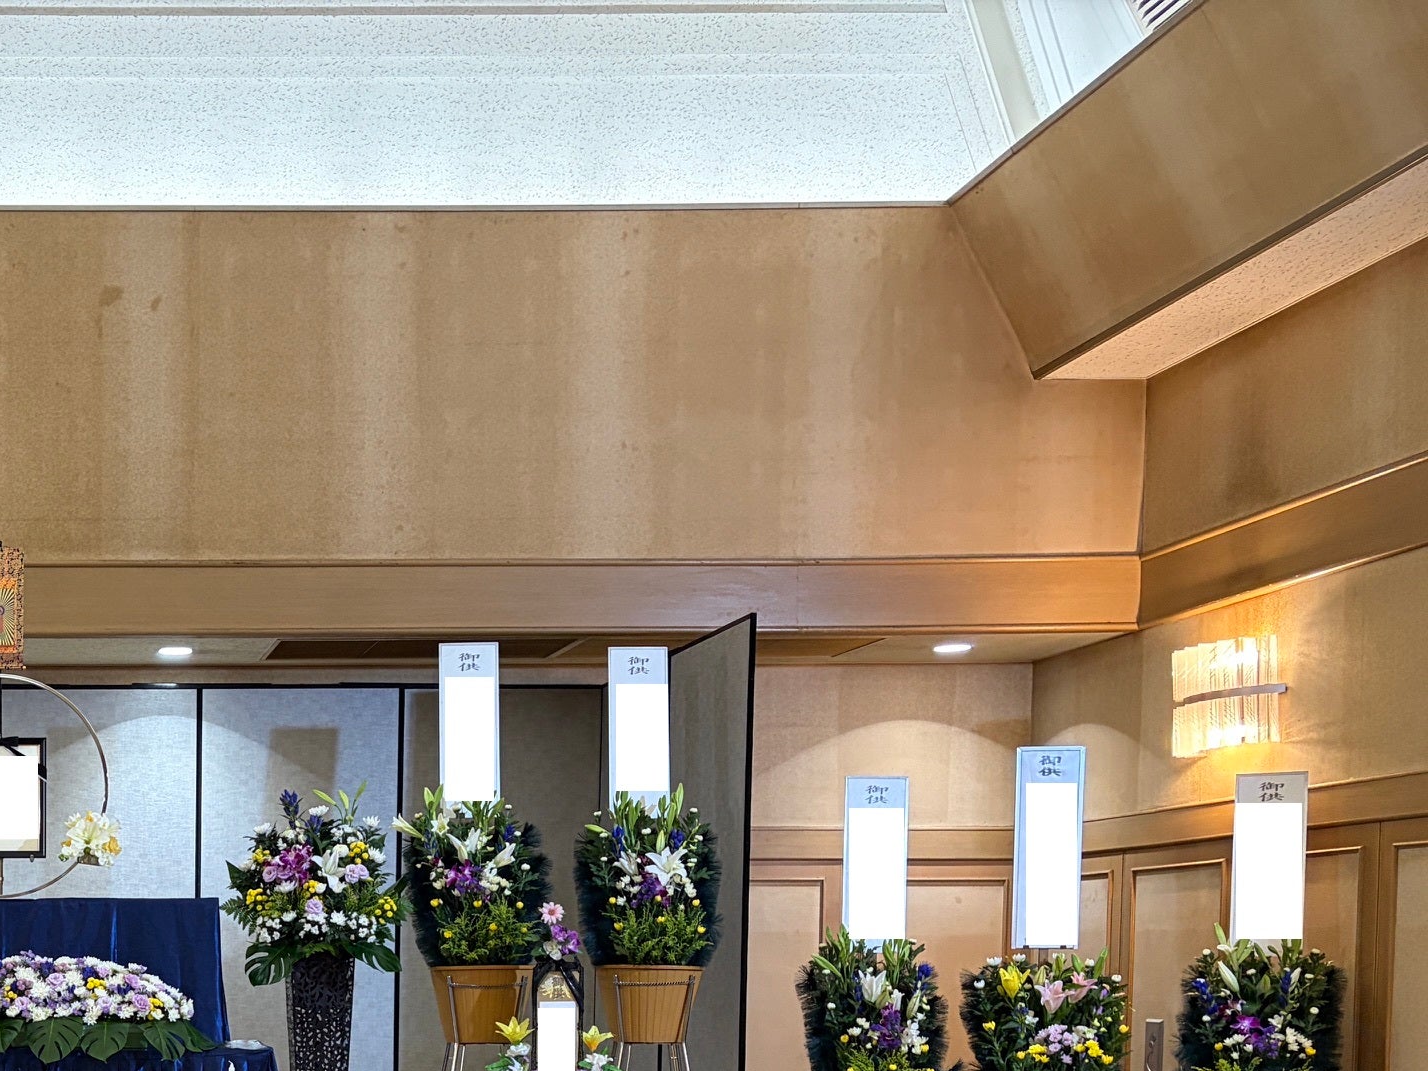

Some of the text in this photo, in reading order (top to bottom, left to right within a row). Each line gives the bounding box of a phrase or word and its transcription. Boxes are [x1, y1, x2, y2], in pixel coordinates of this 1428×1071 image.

[458, 653, 481, 672] 御供
[627, 656, 650, 675] 御供
[1038, 755, 1062, 776] 御供
[865, 785, 889, 804] 御供
[1259, 781, 1285, 802] 御供
